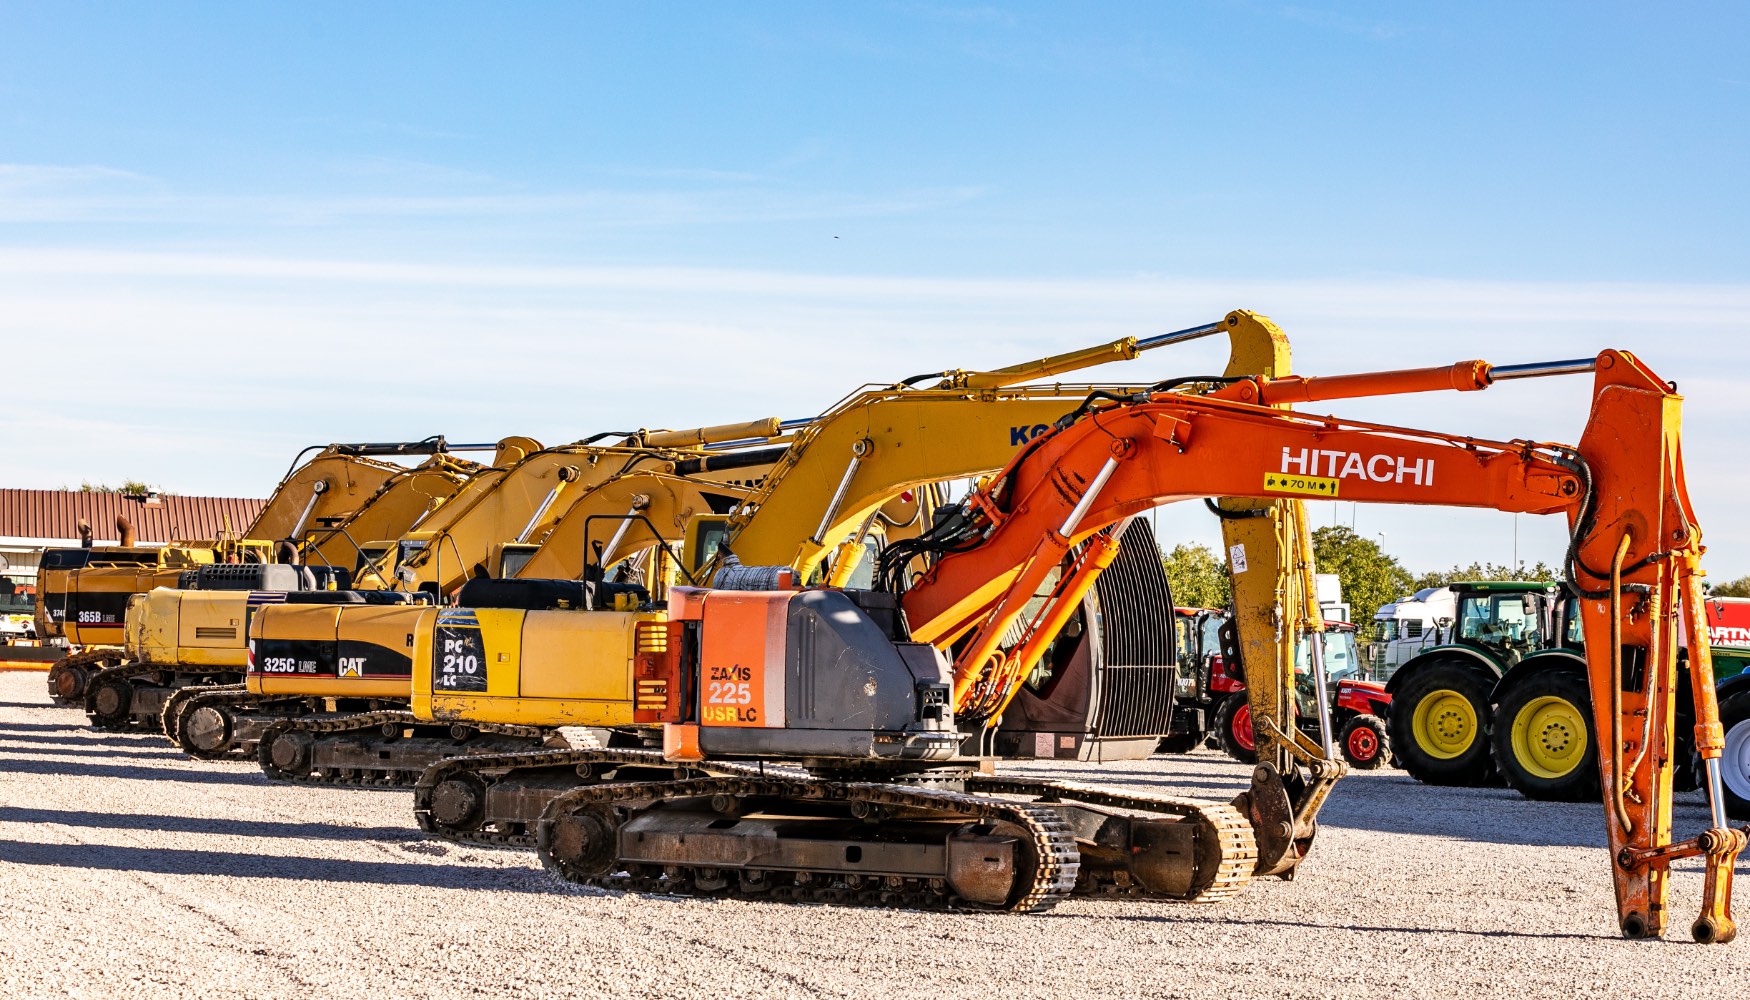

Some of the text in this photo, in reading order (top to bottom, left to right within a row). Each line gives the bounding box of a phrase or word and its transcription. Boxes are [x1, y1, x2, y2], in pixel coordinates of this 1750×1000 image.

[1281, 446, 1435, 487] HITACHI
[1290, 479, 1317, 490] 70 M
[78, 610, 102, 623] 365B
[444, 639, 464, 654] PC
[264, 657, 317, 674] 325C LME
[338, 657, 365, 678] CAT
[443, 654, 478, 675] 210
[710, 664, 752, 682] ZAXIS
[443, 674, 457, 687] LC
[708, 681, 752, 705] 225
